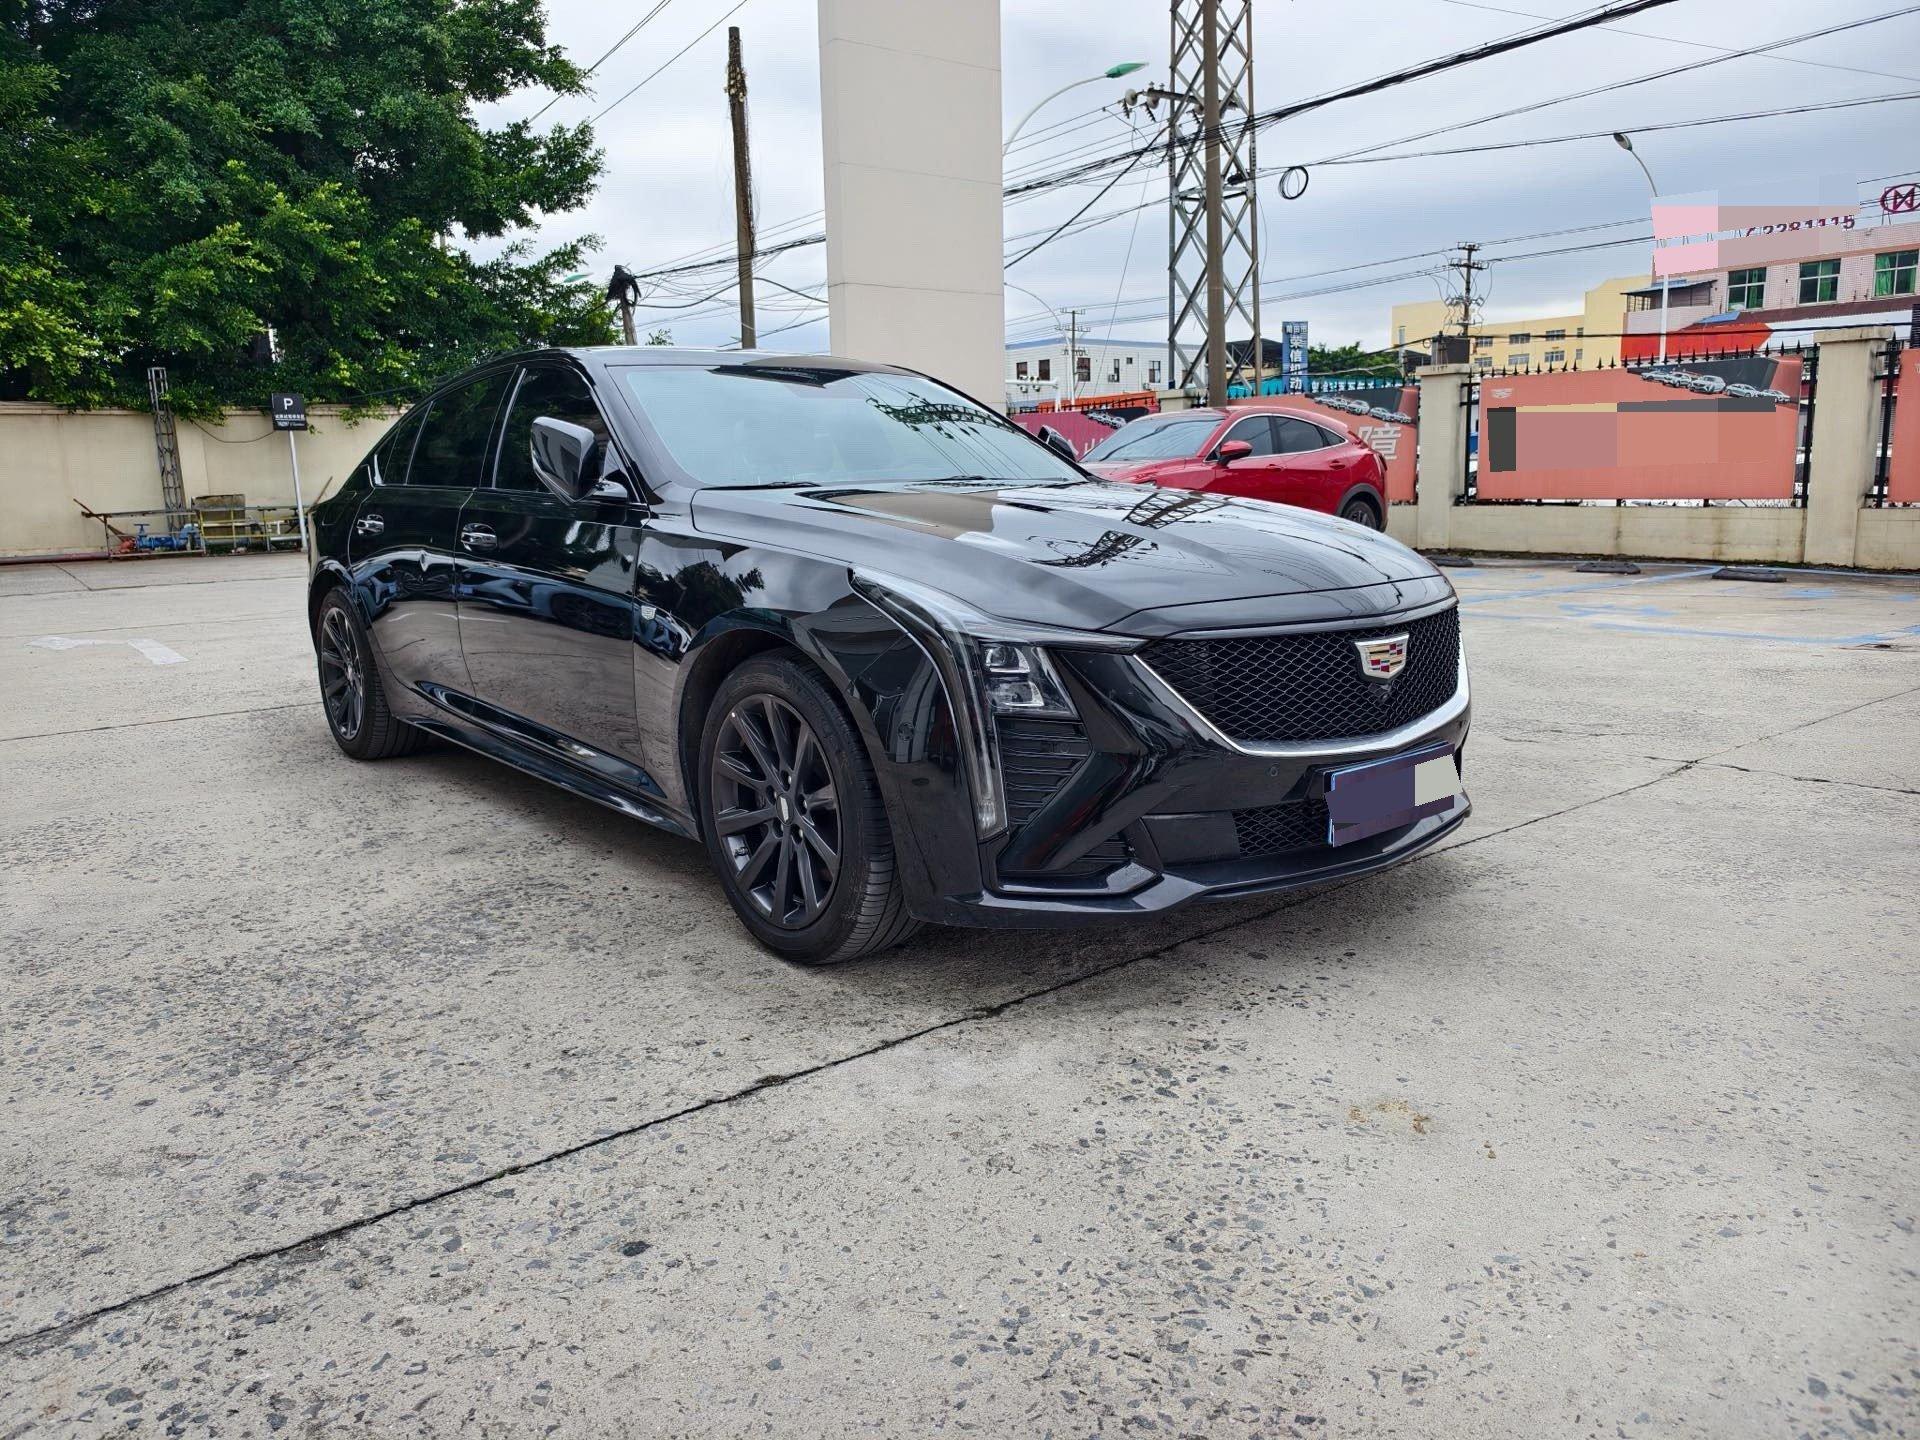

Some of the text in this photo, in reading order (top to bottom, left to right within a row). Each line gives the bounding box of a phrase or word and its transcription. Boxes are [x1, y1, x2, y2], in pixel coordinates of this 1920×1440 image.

[1289, 335, 1302, 395] 荣信机动
[283, 398, 294, 410] P
